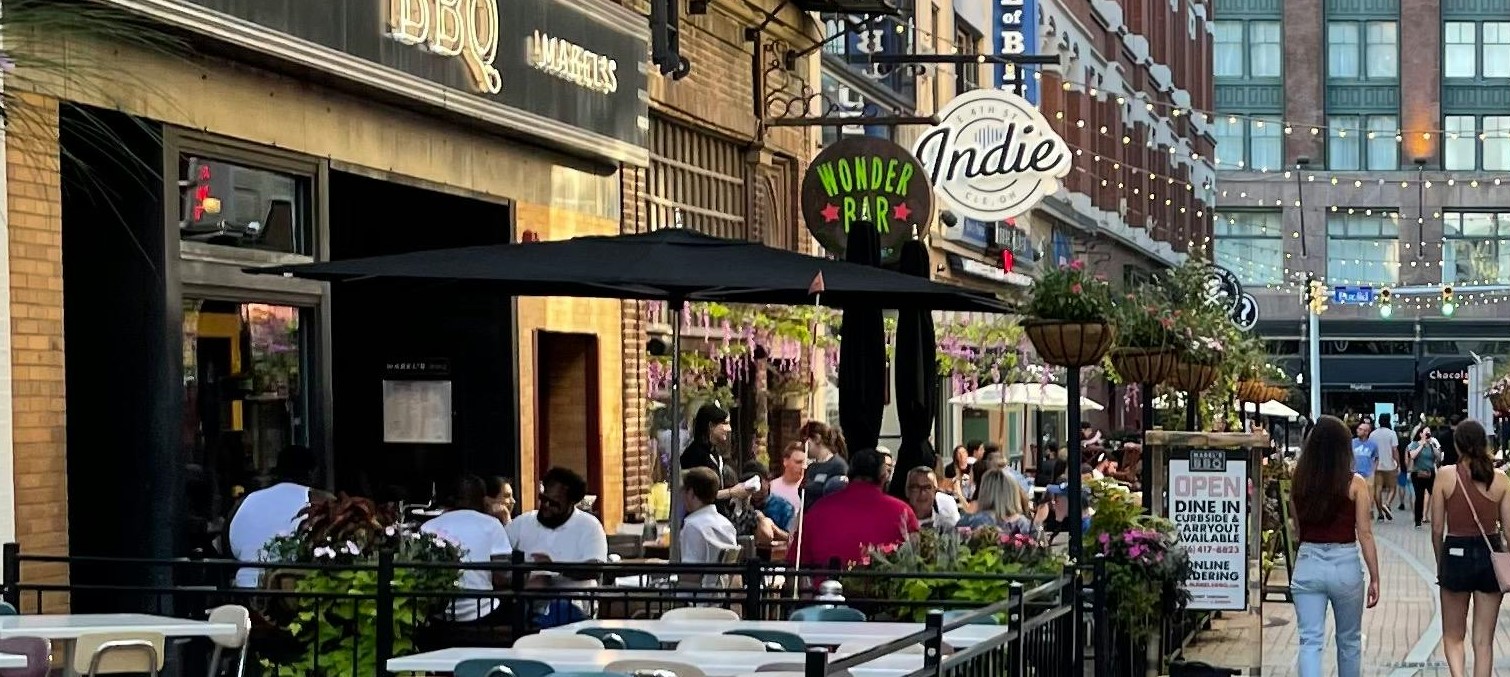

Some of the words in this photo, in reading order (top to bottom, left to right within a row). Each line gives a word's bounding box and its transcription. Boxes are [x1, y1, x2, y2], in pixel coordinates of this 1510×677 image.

[1003, 10, 1021, 24] of
[916, 122, 1065, 188] Indie
[816, 155, 914, 198] WONDER
[1175, 475, 1241, 498] OPEN
[1175, 500, 1217, 514] DINE
[1222, 500, 1241, 514] IN
[1175, 514, 1229, 523] CURBSIDE
[1231, 514, 1240, 523] &
[1176, 533, 1240, 543] AVAILABLE
